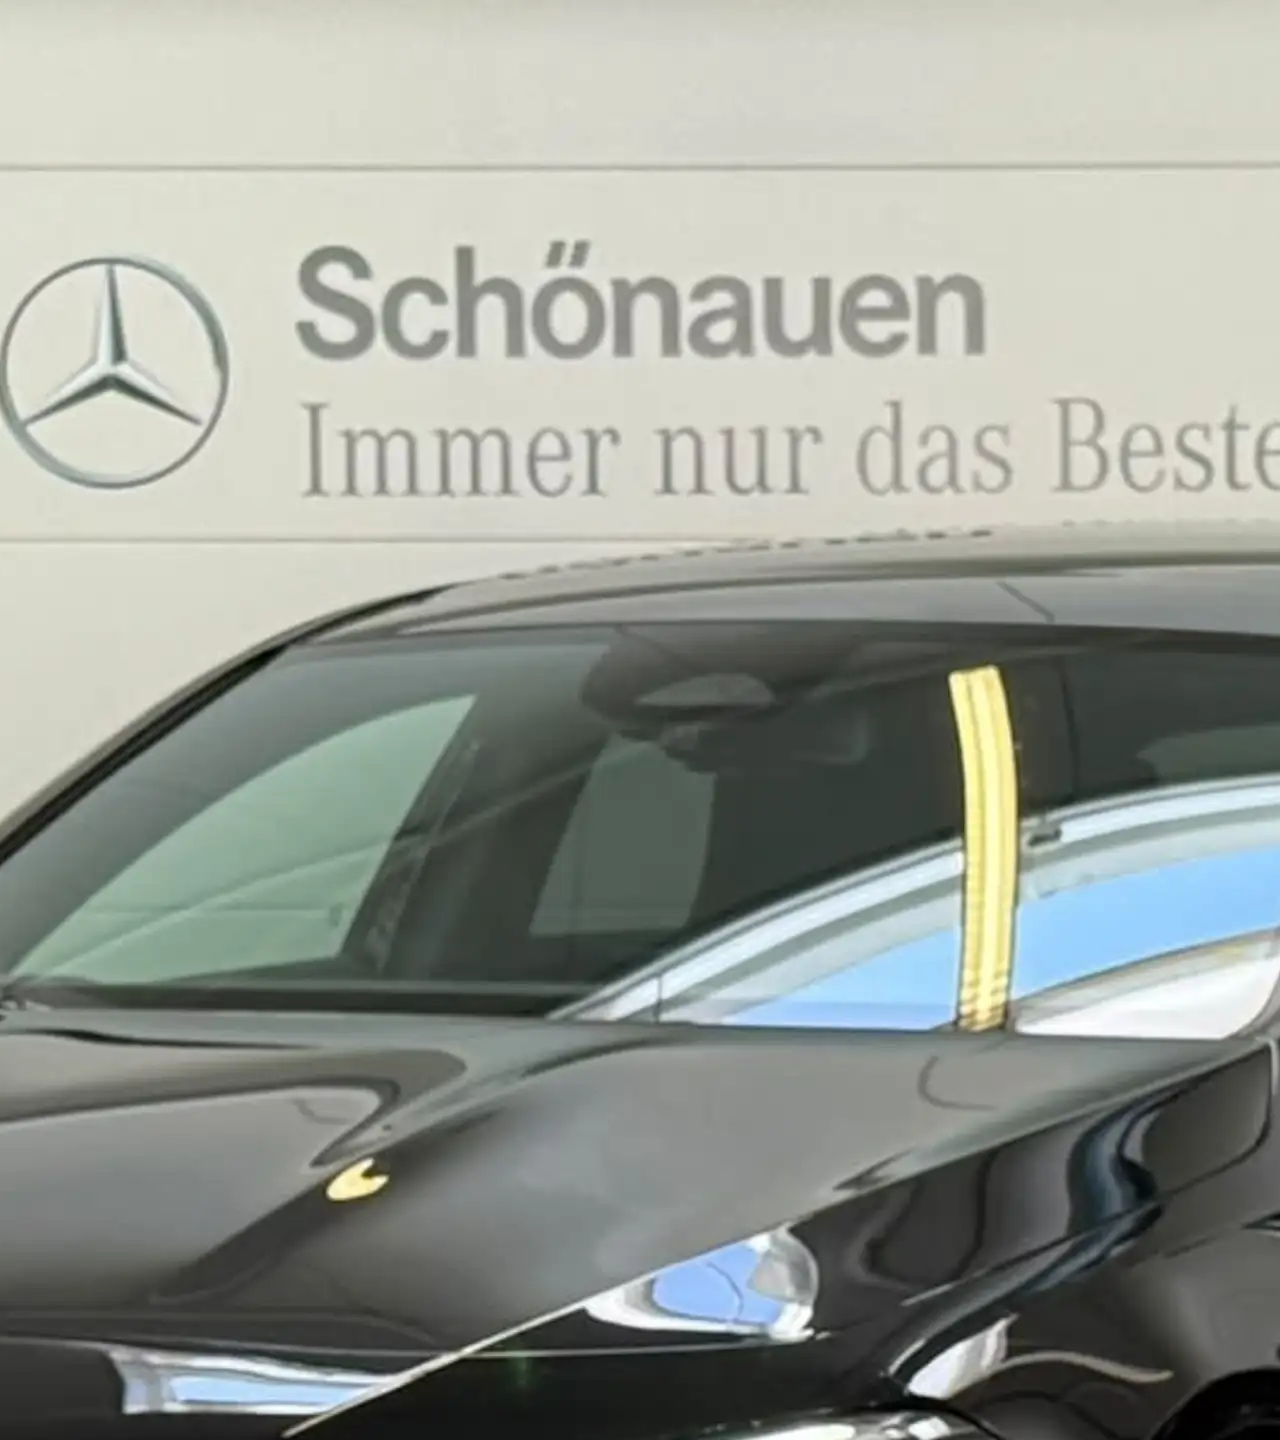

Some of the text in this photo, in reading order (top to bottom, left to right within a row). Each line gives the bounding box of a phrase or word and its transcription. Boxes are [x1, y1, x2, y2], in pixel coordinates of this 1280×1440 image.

[295, 240, 987, 363] Schönauen
[301, 402, 623, 500] Immer
[654, 424, 826, 499] nur
[855, 399, 1016, 499] das
